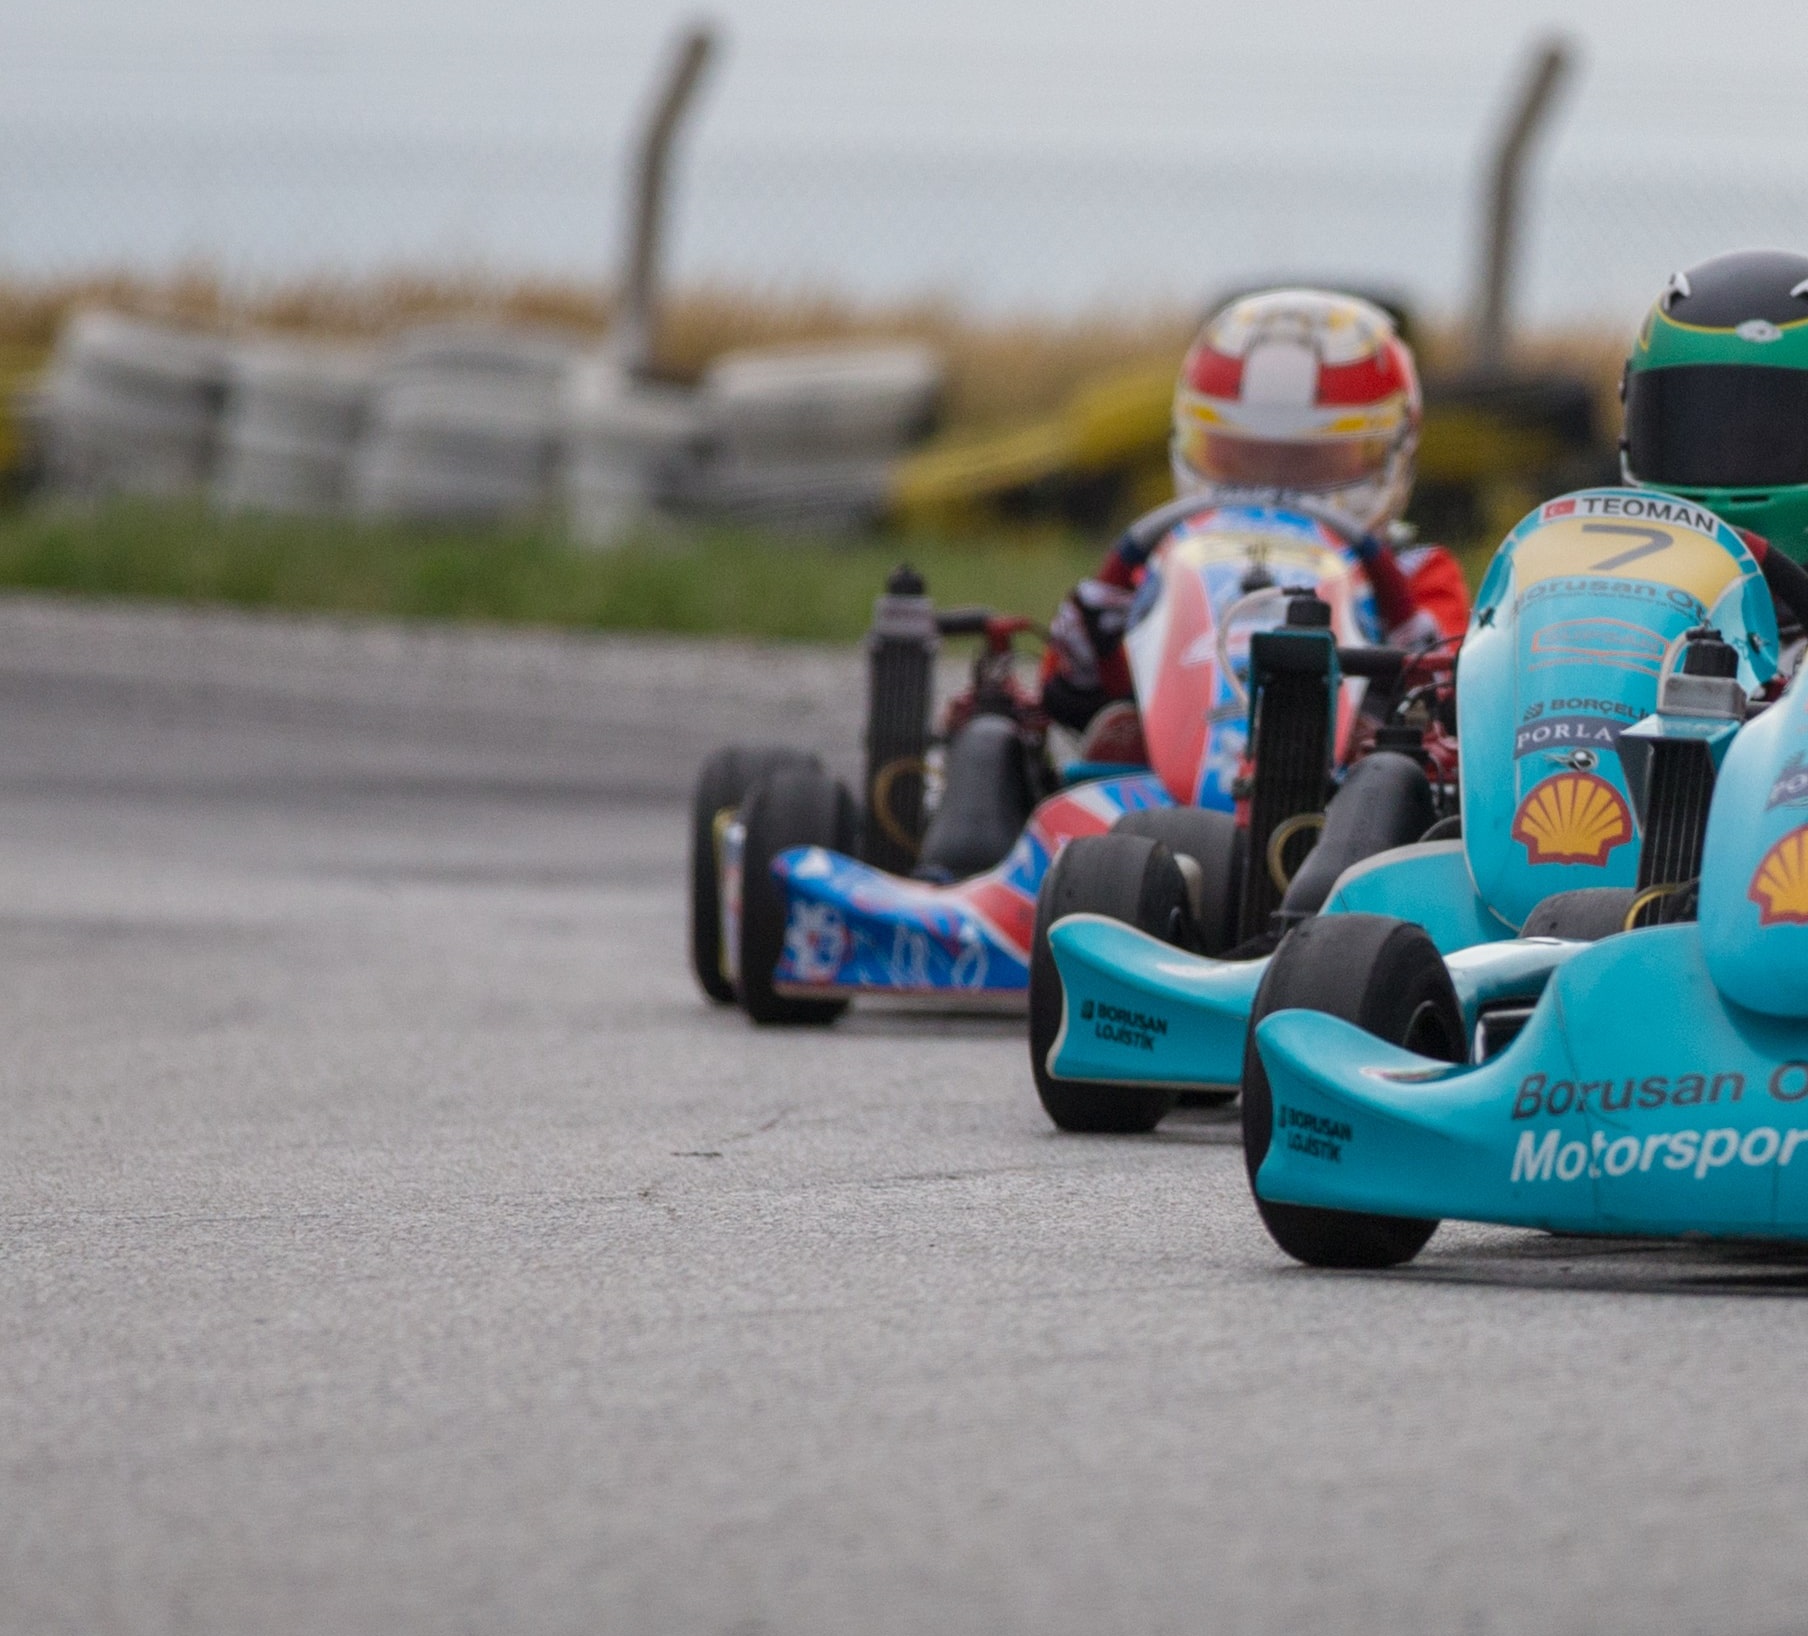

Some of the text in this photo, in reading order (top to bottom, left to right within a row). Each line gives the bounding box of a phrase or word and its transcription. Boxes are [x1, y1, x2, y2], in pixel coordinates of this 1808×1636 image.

[1582, 497, 1714, 533] TEOMAN
[1582, 523, 1674, 571] 7
[1517, 723, 1615, 750] PORLA
[1098, 1003, 1168, 1036] BORUSAN
[1511, 1072, 1746, 1121] Borusan
[1288, 1106, 1352, 1142] BORUSAN
